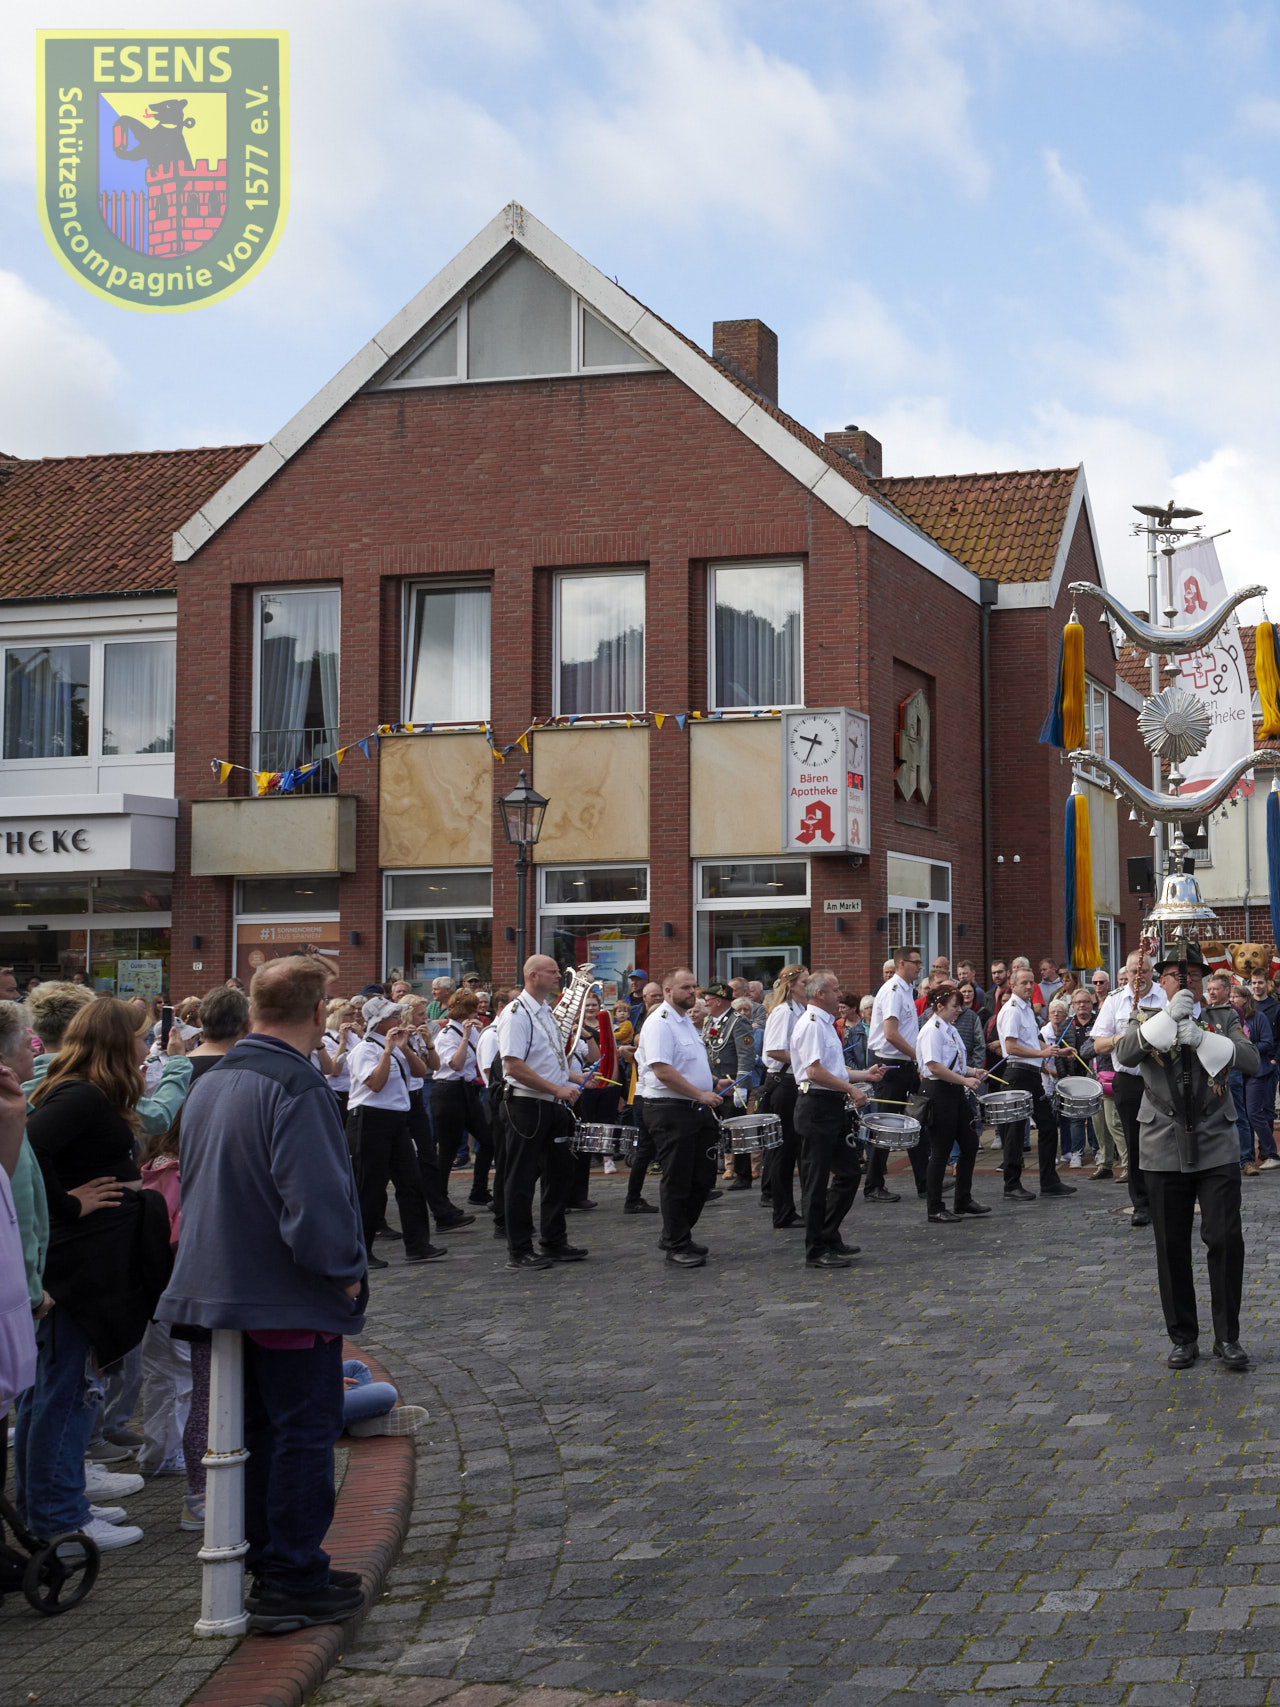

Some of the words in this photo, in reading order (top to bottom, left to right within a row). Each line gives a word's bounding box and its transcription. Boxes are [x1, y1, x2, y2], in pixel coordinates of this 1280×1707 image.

[800, 774, 828, 783] Bären
[790, 787, 838, 798] Apotheke
[0, 829, 91, 854] HEKE
[826, 902, 838, 910] Am
[839, 901, 859, 910] Markt
